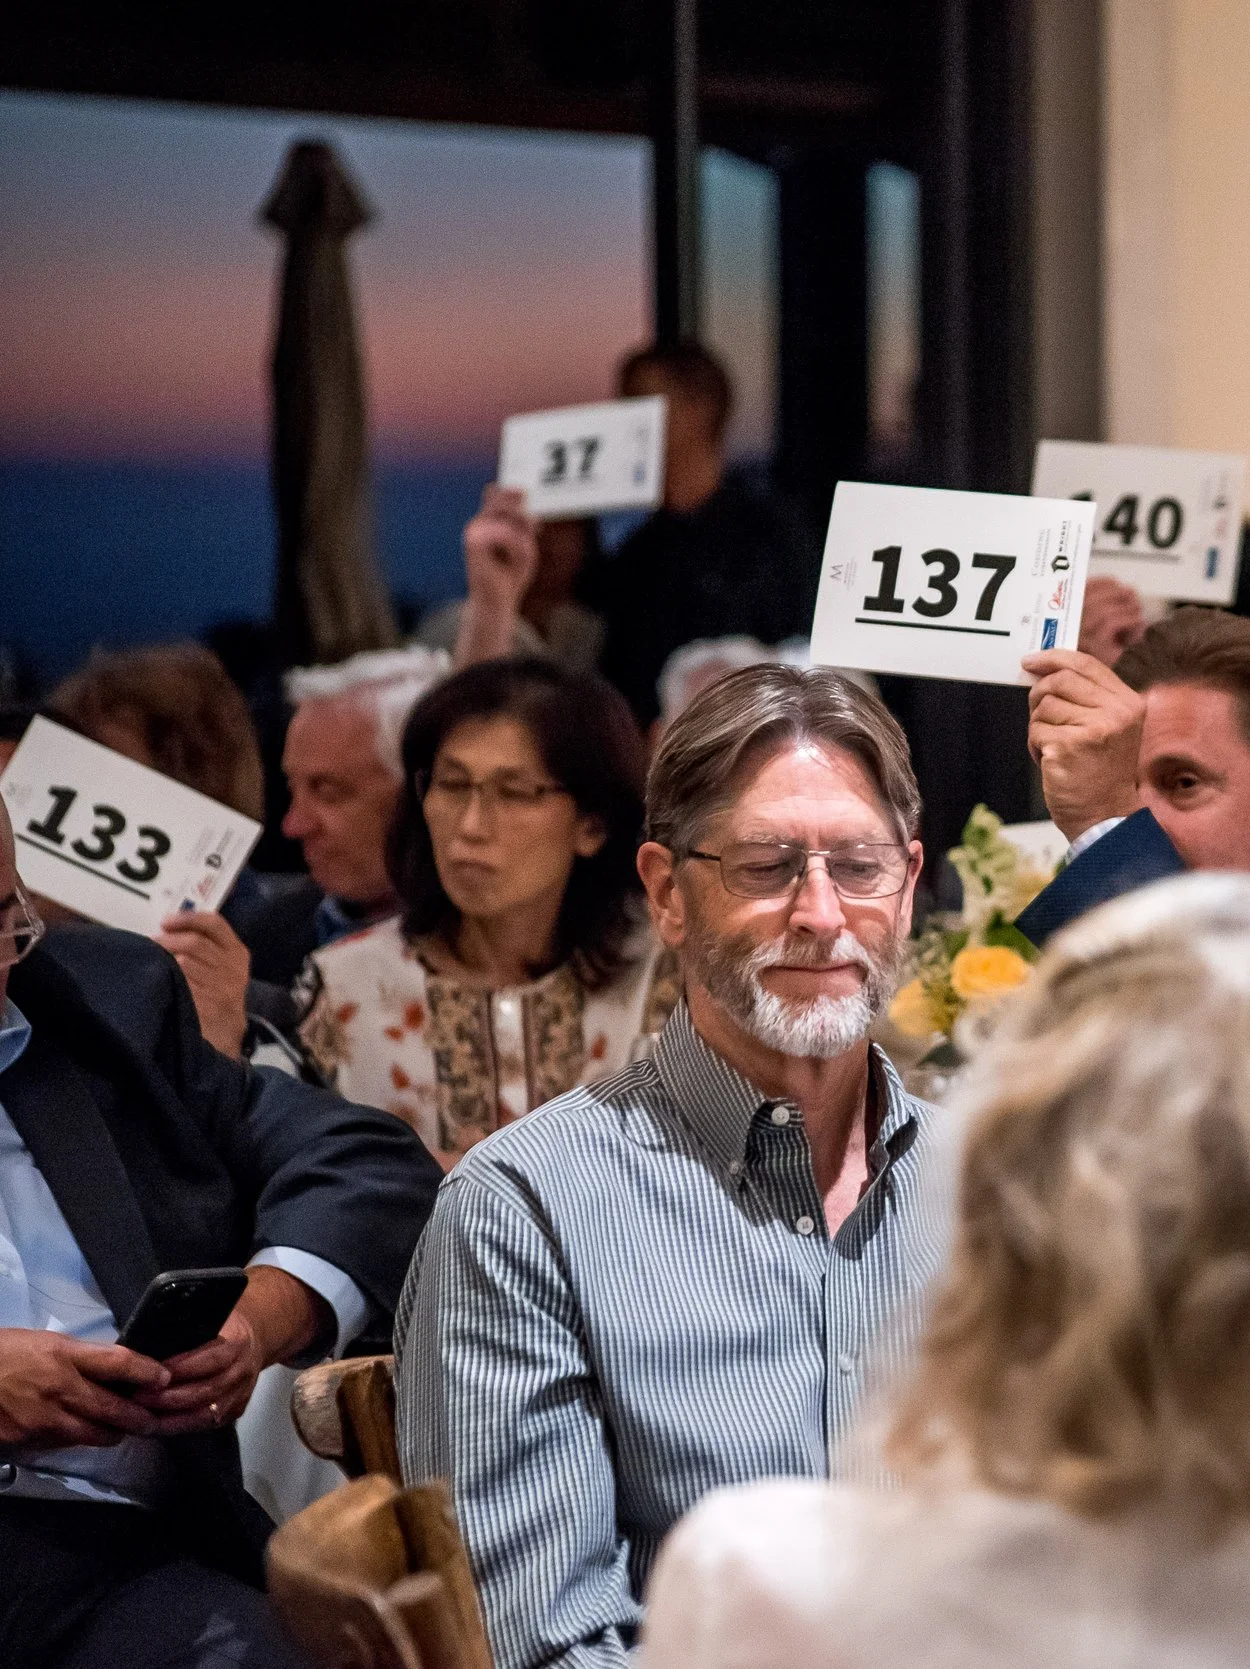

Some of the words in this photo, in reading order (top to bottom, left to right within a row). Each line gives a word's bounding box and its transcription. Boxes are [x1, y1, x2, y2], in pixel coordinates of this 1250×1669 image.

[540, 435, 602, 487] 37
[1070, 489, 1184, 549] 40
[864, 546, 1017, 622] 137
[28, 786, 171, 884] 133
